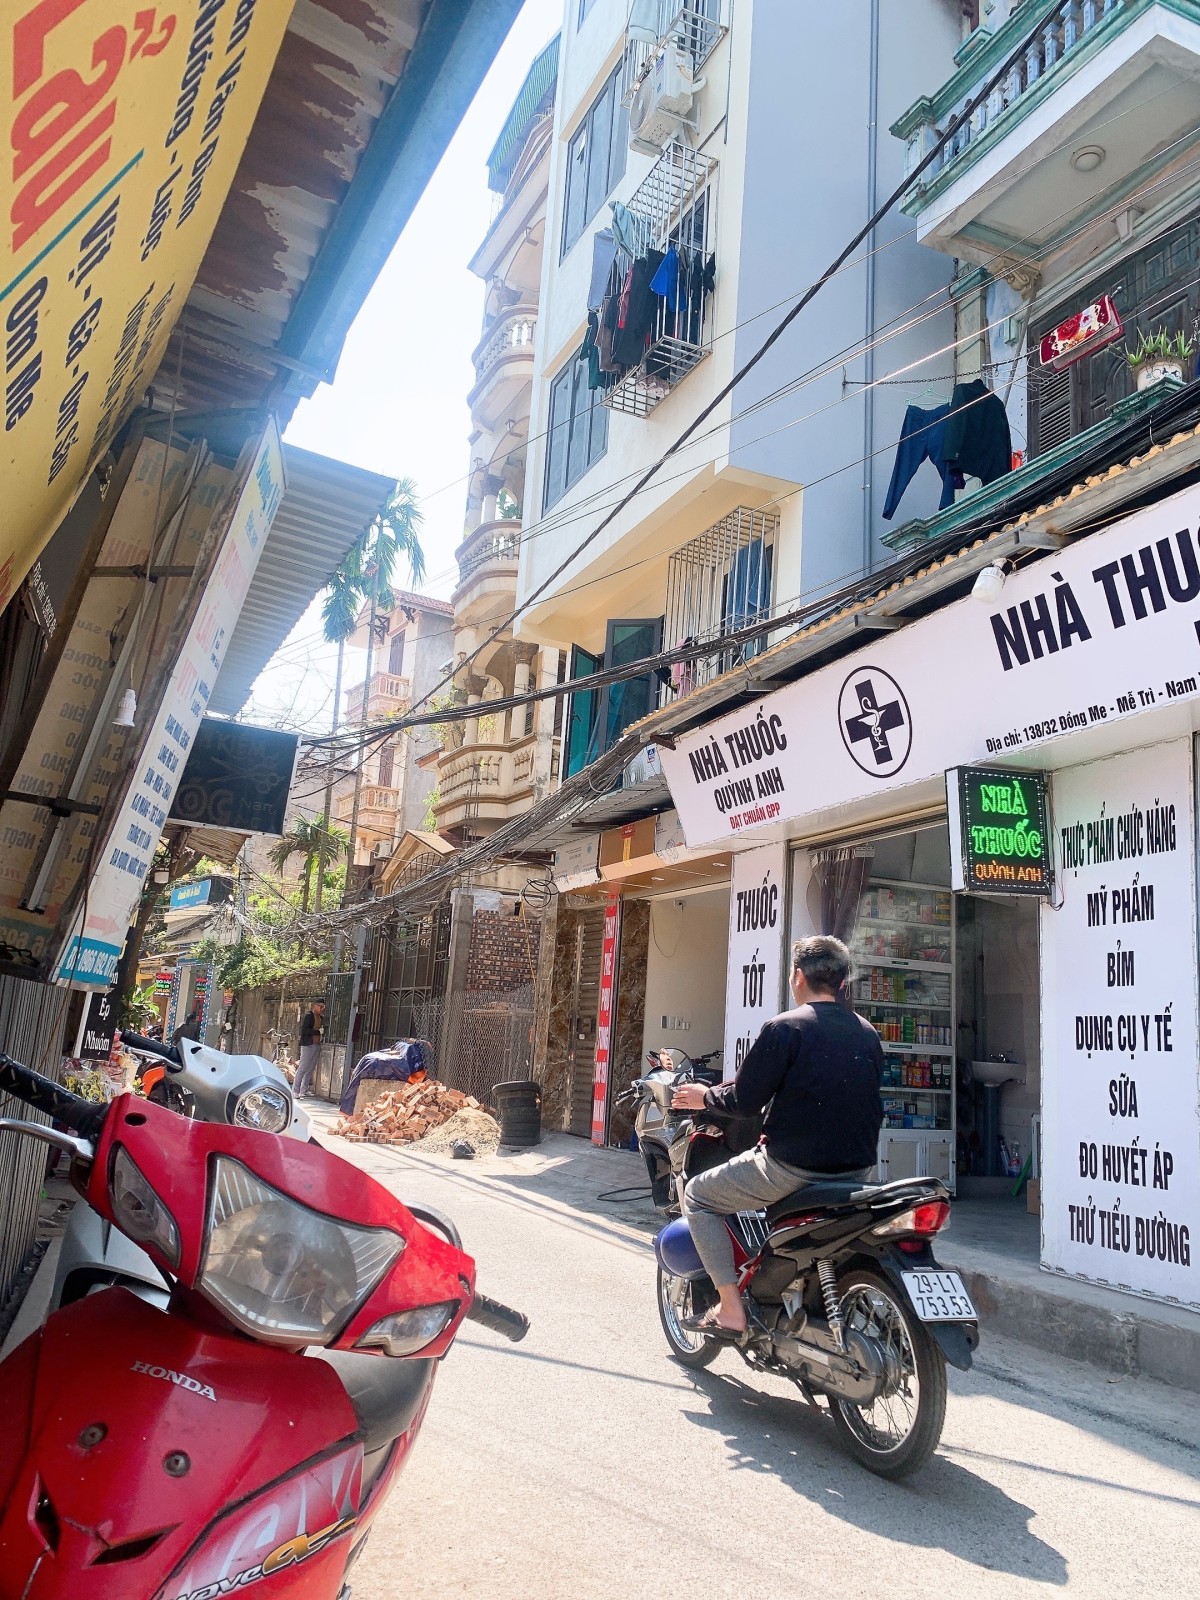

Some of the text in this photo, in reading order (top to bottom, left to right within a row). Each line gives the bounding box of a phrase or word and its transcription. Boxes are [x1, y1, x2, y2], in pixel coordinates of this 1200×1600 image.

[140, 163, 184, 262] Luộc
[68, 194, 121, 290] Vịt
[6, 275, 48, 374] Om
[65, 297, 103, 369] Gà
[55, 371, 90, 441] Om
[989, 515, 1200, 671] NHÀ THU
[985, 737, 1003, 754] Địa
[1003, 728, 1023, 749] chỉ:
[1022, 718, 1059, 743] 138/32
[1087, 703, 1108, 722] Me
[1116, 691, 1137, 714] Mễ
[1137, 687, 1156, 707] Trì
[1165, 676, 1198, 699] Nam
[688, 704, 787, 784] NHÀ THUỐC
[713, 766, 785, 814] QUỲNH ANH
[729, 801, 781, 831] ĐẠT CHUẨN GPP
[980, 780, 1028, 816] NHÀ
[971, 818, 1042, 858] THUỐC
[1061, 798, 1177, 878] THỰC PHẨM CHỨC NĂNG
[974, 860, 1042, 882] QUỲNH ANH
[1087, 871, 1155, 927] MỸ PHẨM
[737, 870, 777, 933] THUỐC
[742, 948, 766, 1008] TỐT
[1107, 939, 1135, 988] BỈM
[98, 991, 110, 1021] Ép
[1075, 1002, 1173, 1060] DỤNG CỤ Y TẾ
[84, 1030, 110, 1056] Nhuộm
[1109, 1072, 1139, 1119] SỮA
[1079, 1136, 1174, 1191] ĐO HUYẾT ÁP
[1068, 1194, 1191, 1267] THỬ TIỂU ĐƯỜNG
[912, 1274, 958, 1293] 29-L1
[916, 1295, 972, 1316] 753.53
[129, 1360, 218, 1402] HONDA
